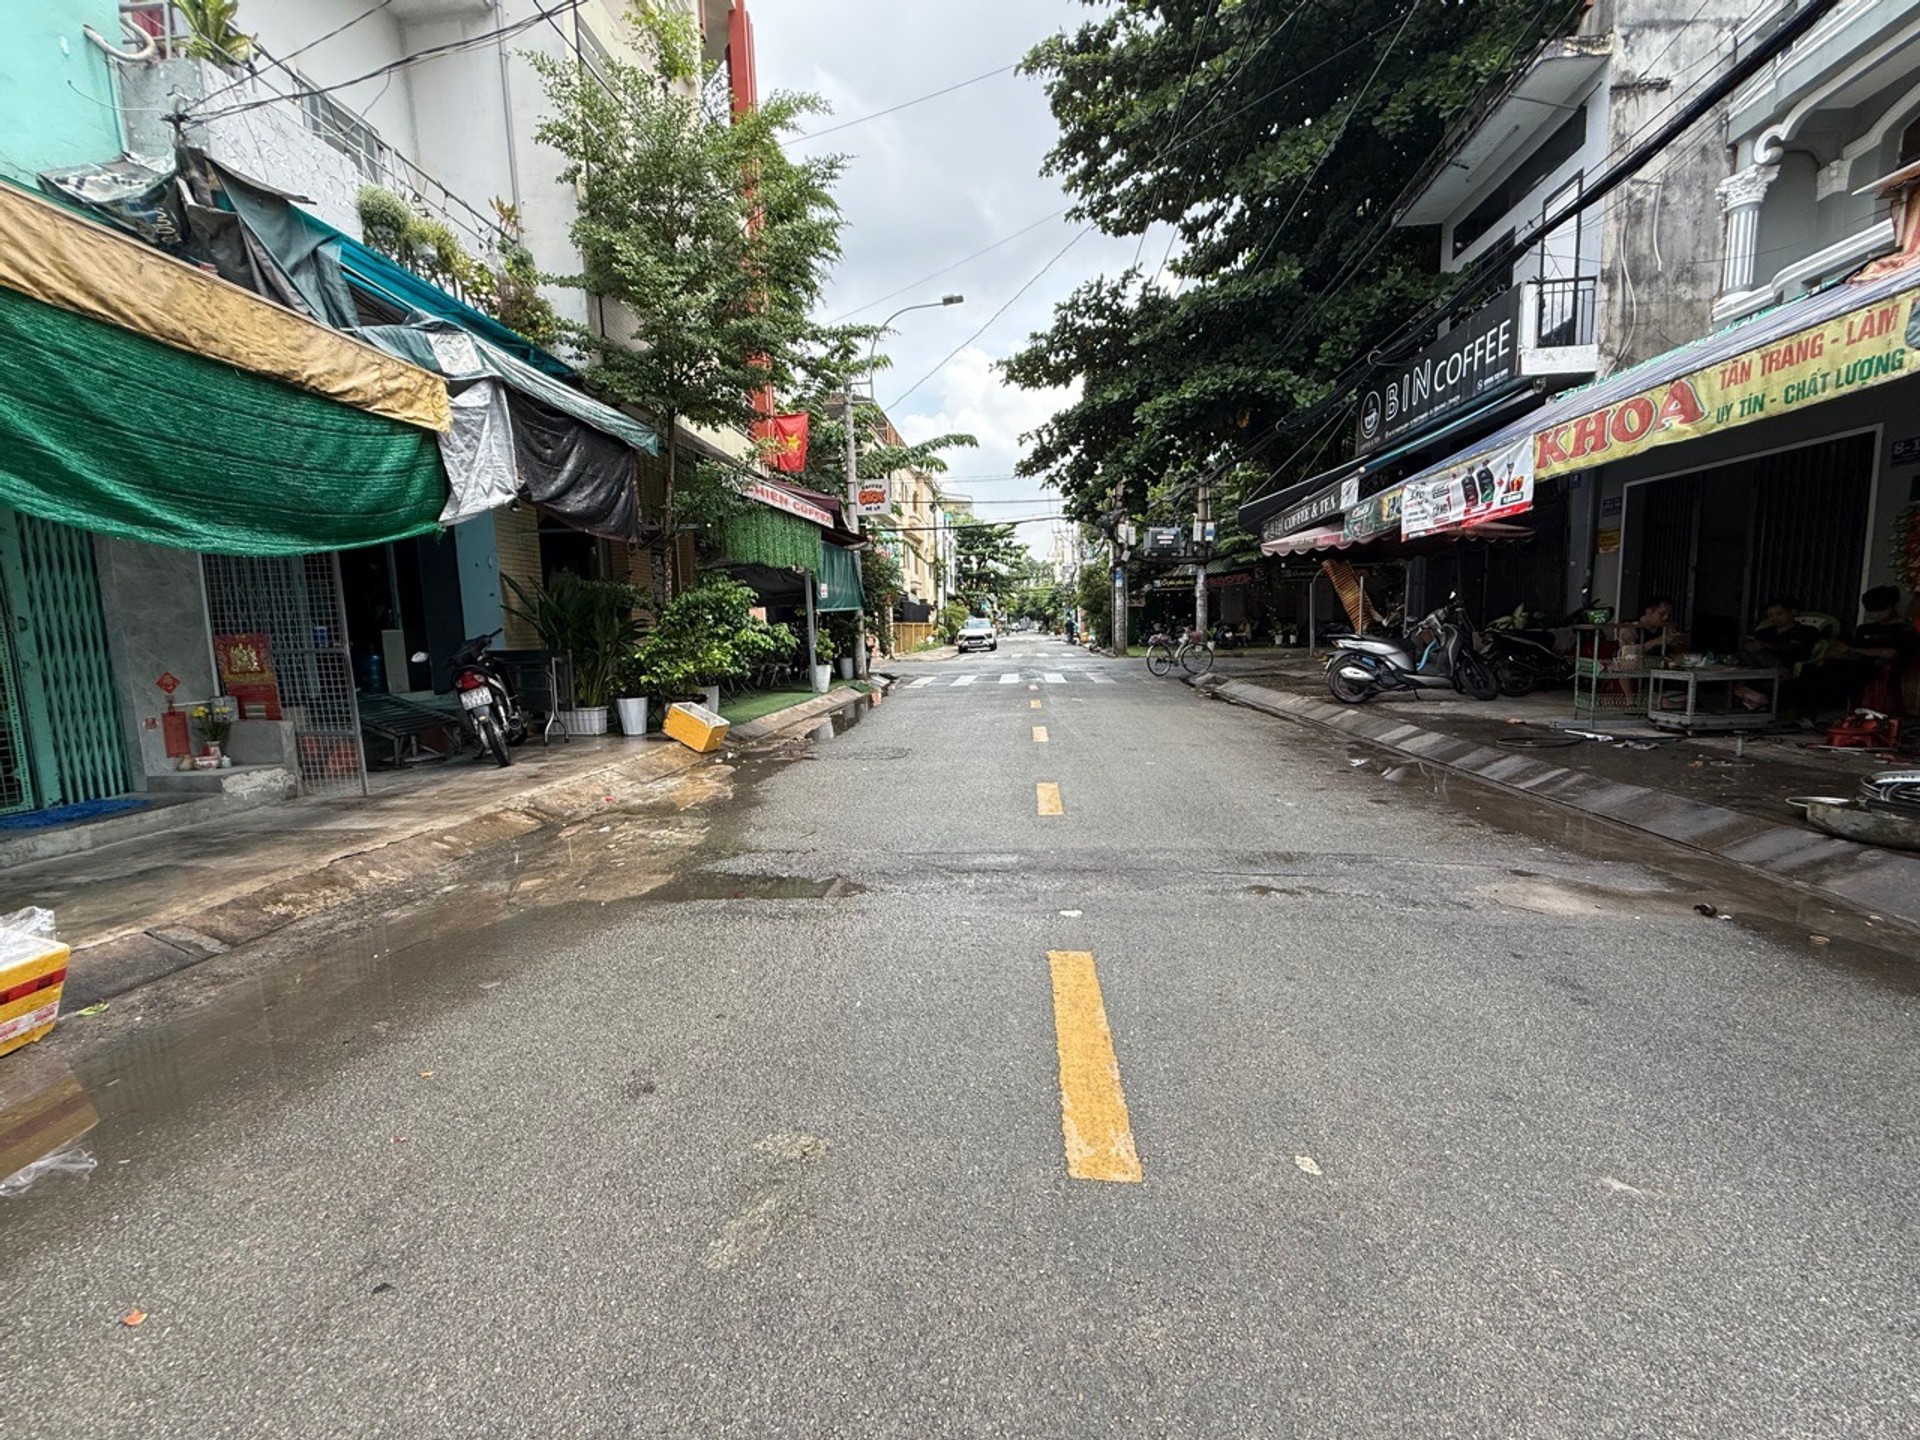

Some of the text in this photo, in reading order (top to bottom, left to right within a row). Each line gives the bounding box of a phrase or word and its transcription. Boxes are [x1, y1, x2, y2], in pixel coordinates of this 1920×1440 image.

[1760, 332, 1824, 377] TRANG
[1846, 304, 1900, 346] LÀM
[1716, 402, 1733, 424] UY
[1739, 389, 1766, 418] TÍN
[1784, 367, 1829, 405] CHẤT
[1835, 348, 1906, 385] LƯỢNG
[1535, 379, 1710, 470] KHOA
